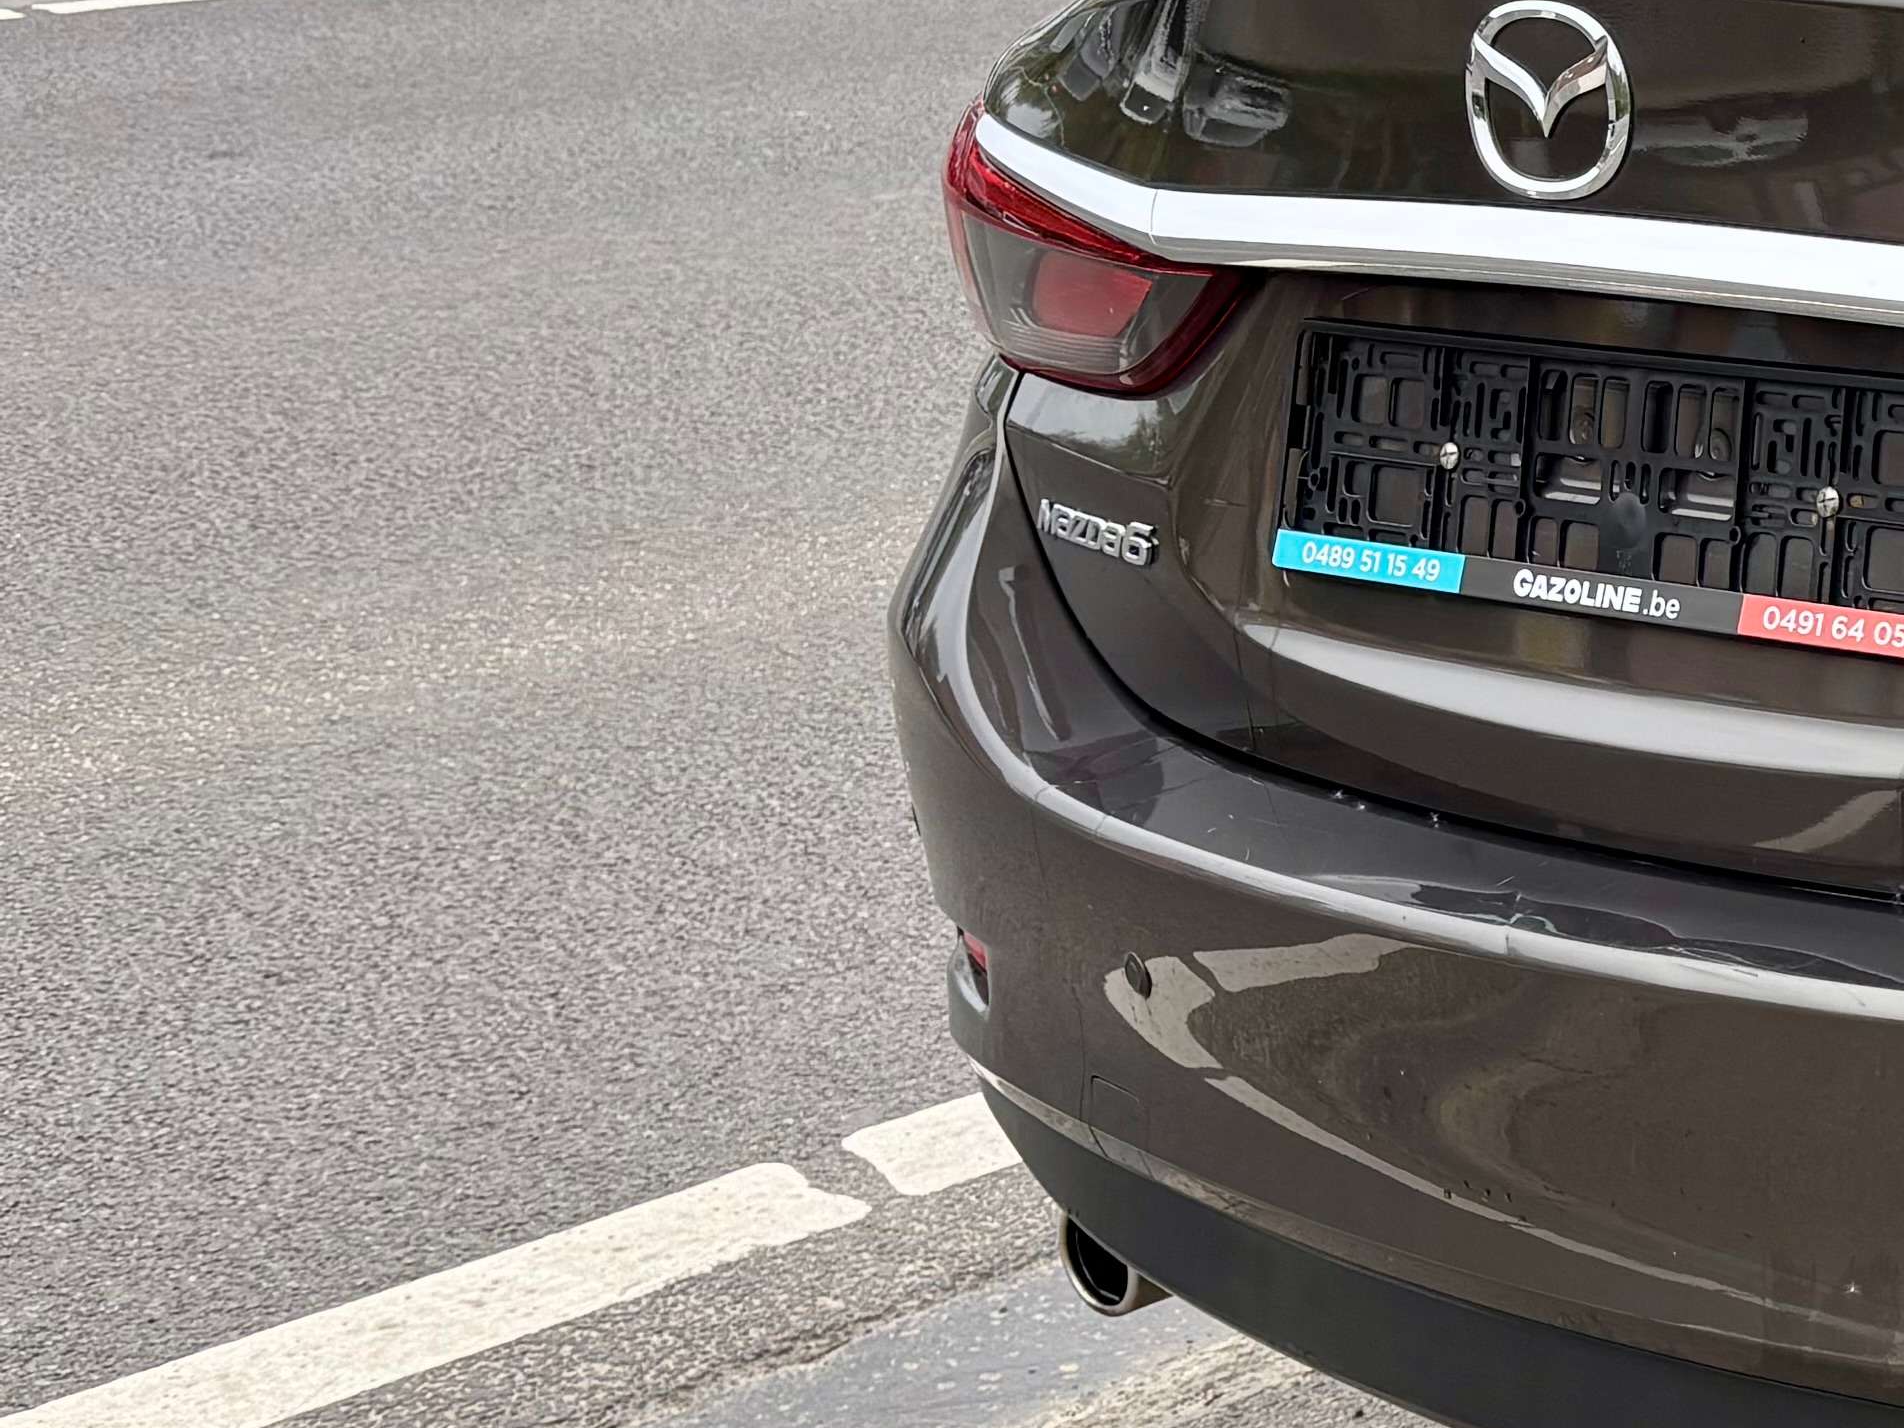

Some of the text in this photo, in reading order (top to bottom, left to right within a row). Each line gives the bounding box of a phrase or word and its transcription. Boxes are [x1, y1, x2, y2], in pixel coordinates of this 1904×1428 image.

[1302, 540, 1441, 583] 0489 51 15 49
[1513, 568, 1681, 619] GAZOLINE.be
[1763, 606, 1824, 637] 0491
[1831, 616, 1865, 642] 64
